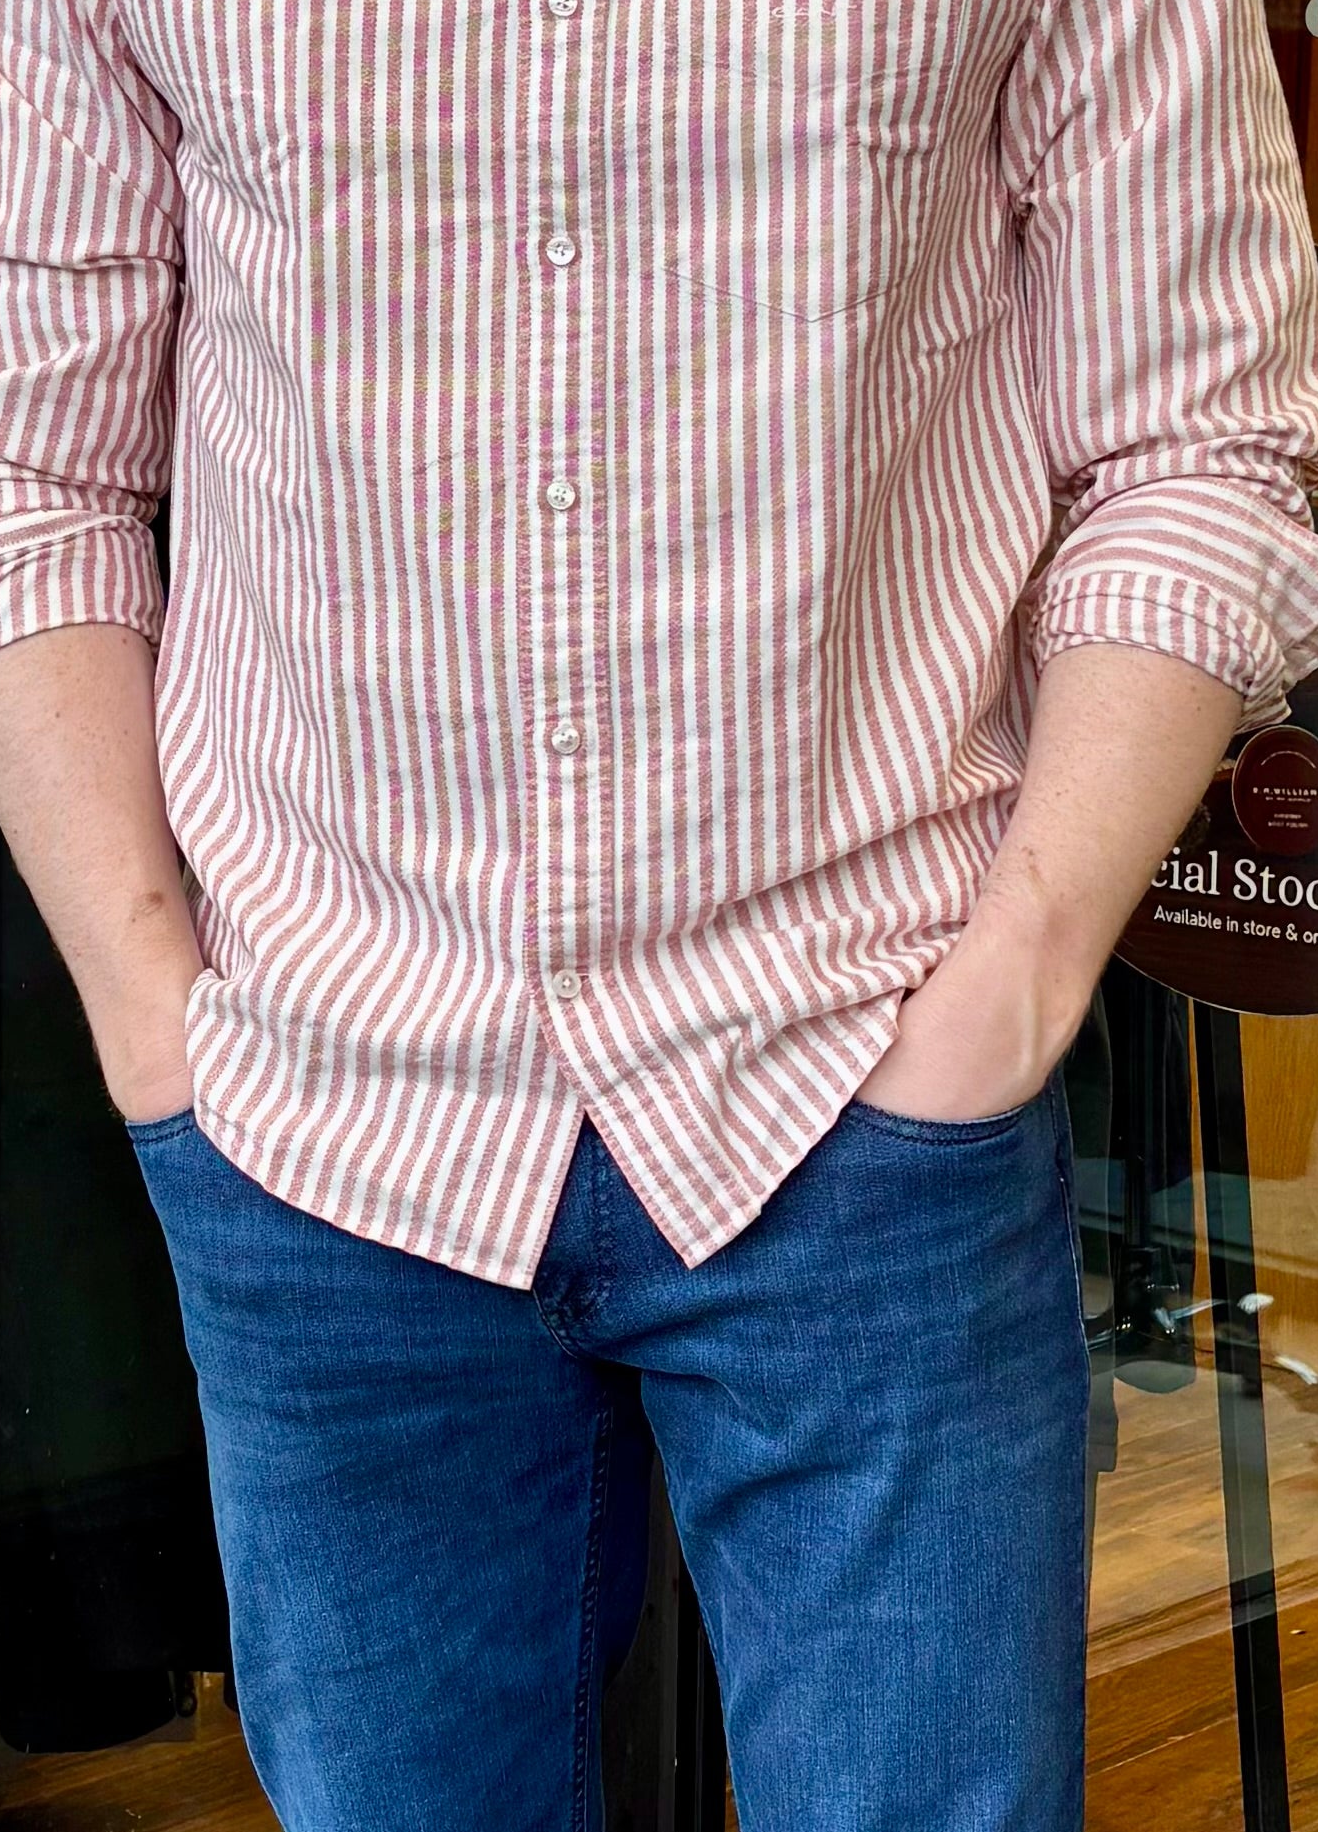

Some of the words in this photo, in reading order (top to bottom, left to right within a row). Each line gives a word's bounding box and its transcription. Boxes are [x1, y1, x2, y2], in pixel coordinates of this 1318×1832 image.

[1150, 847, 1221, 896] cial
[1153, 904, 1222, 930] Available
[1226, 916, 1239, 933] in
[1243, 920, 1281, 939] store
[1285, 923, 1298, 941] &
